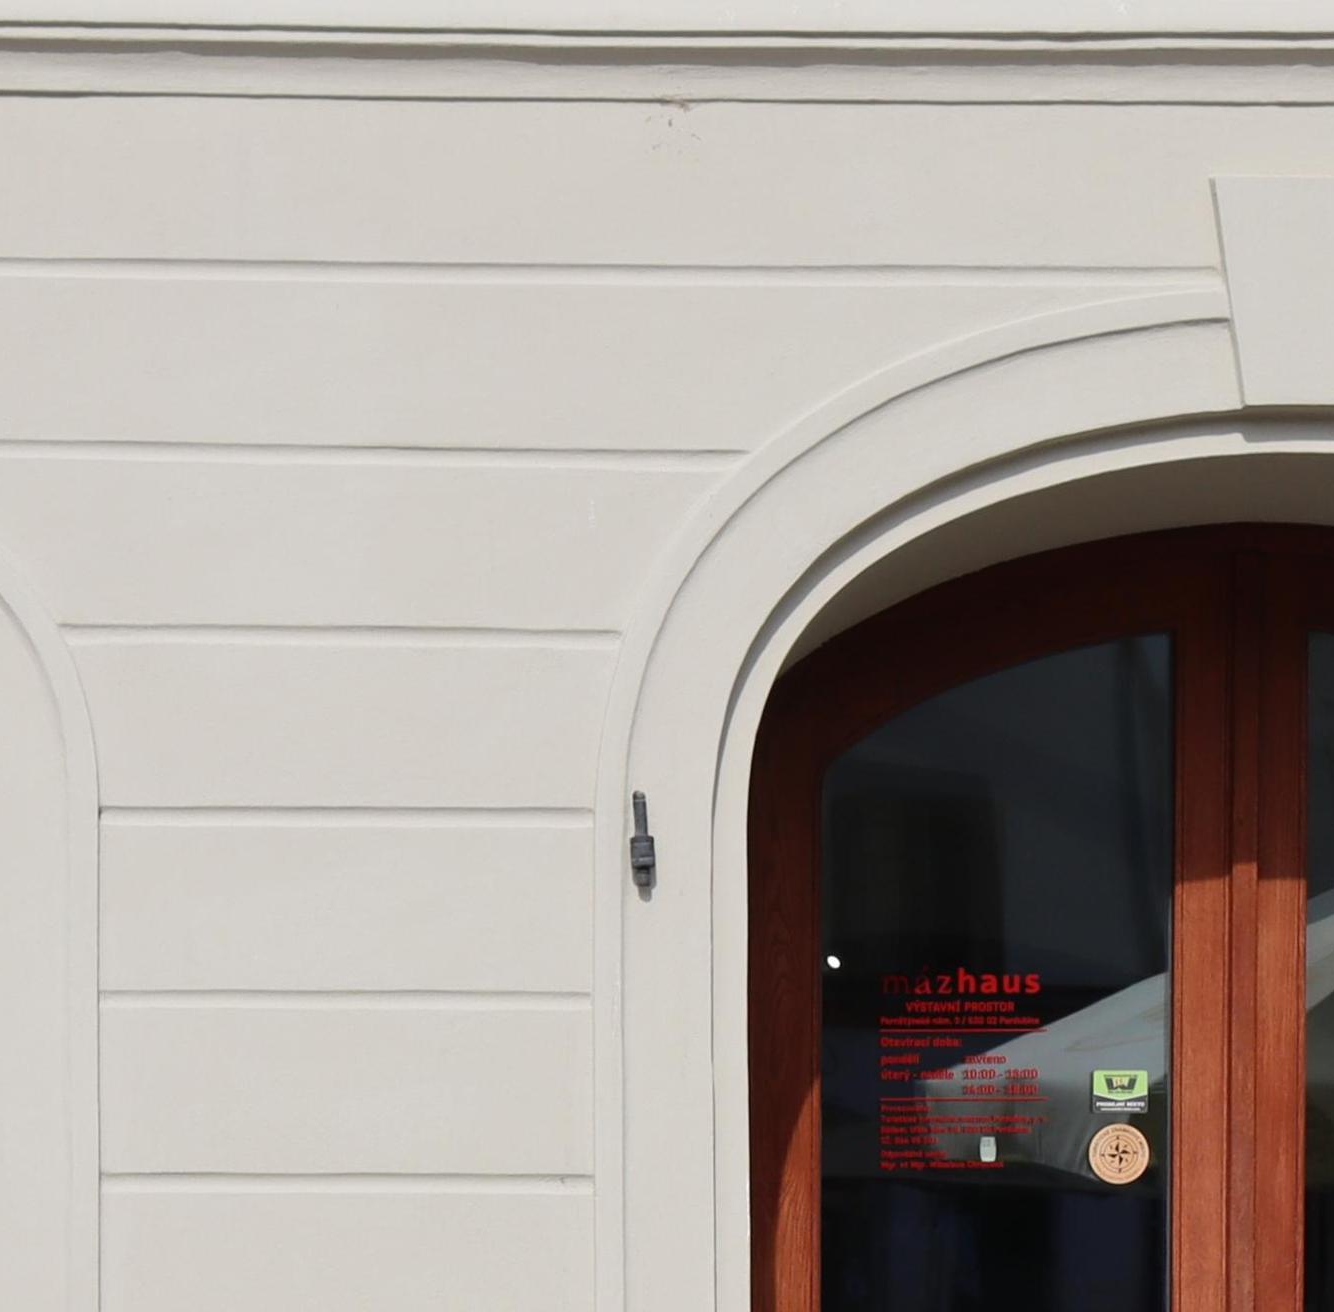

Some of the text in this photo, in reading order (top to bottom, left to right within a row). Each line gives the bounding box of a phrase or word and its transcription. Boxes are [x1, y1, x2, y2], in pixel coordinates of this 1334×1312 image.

[882, 965, 1042, 994] mázhaus
[905, 1000, 1015, 1012] VÝSTAVNÍ PROSTOR
